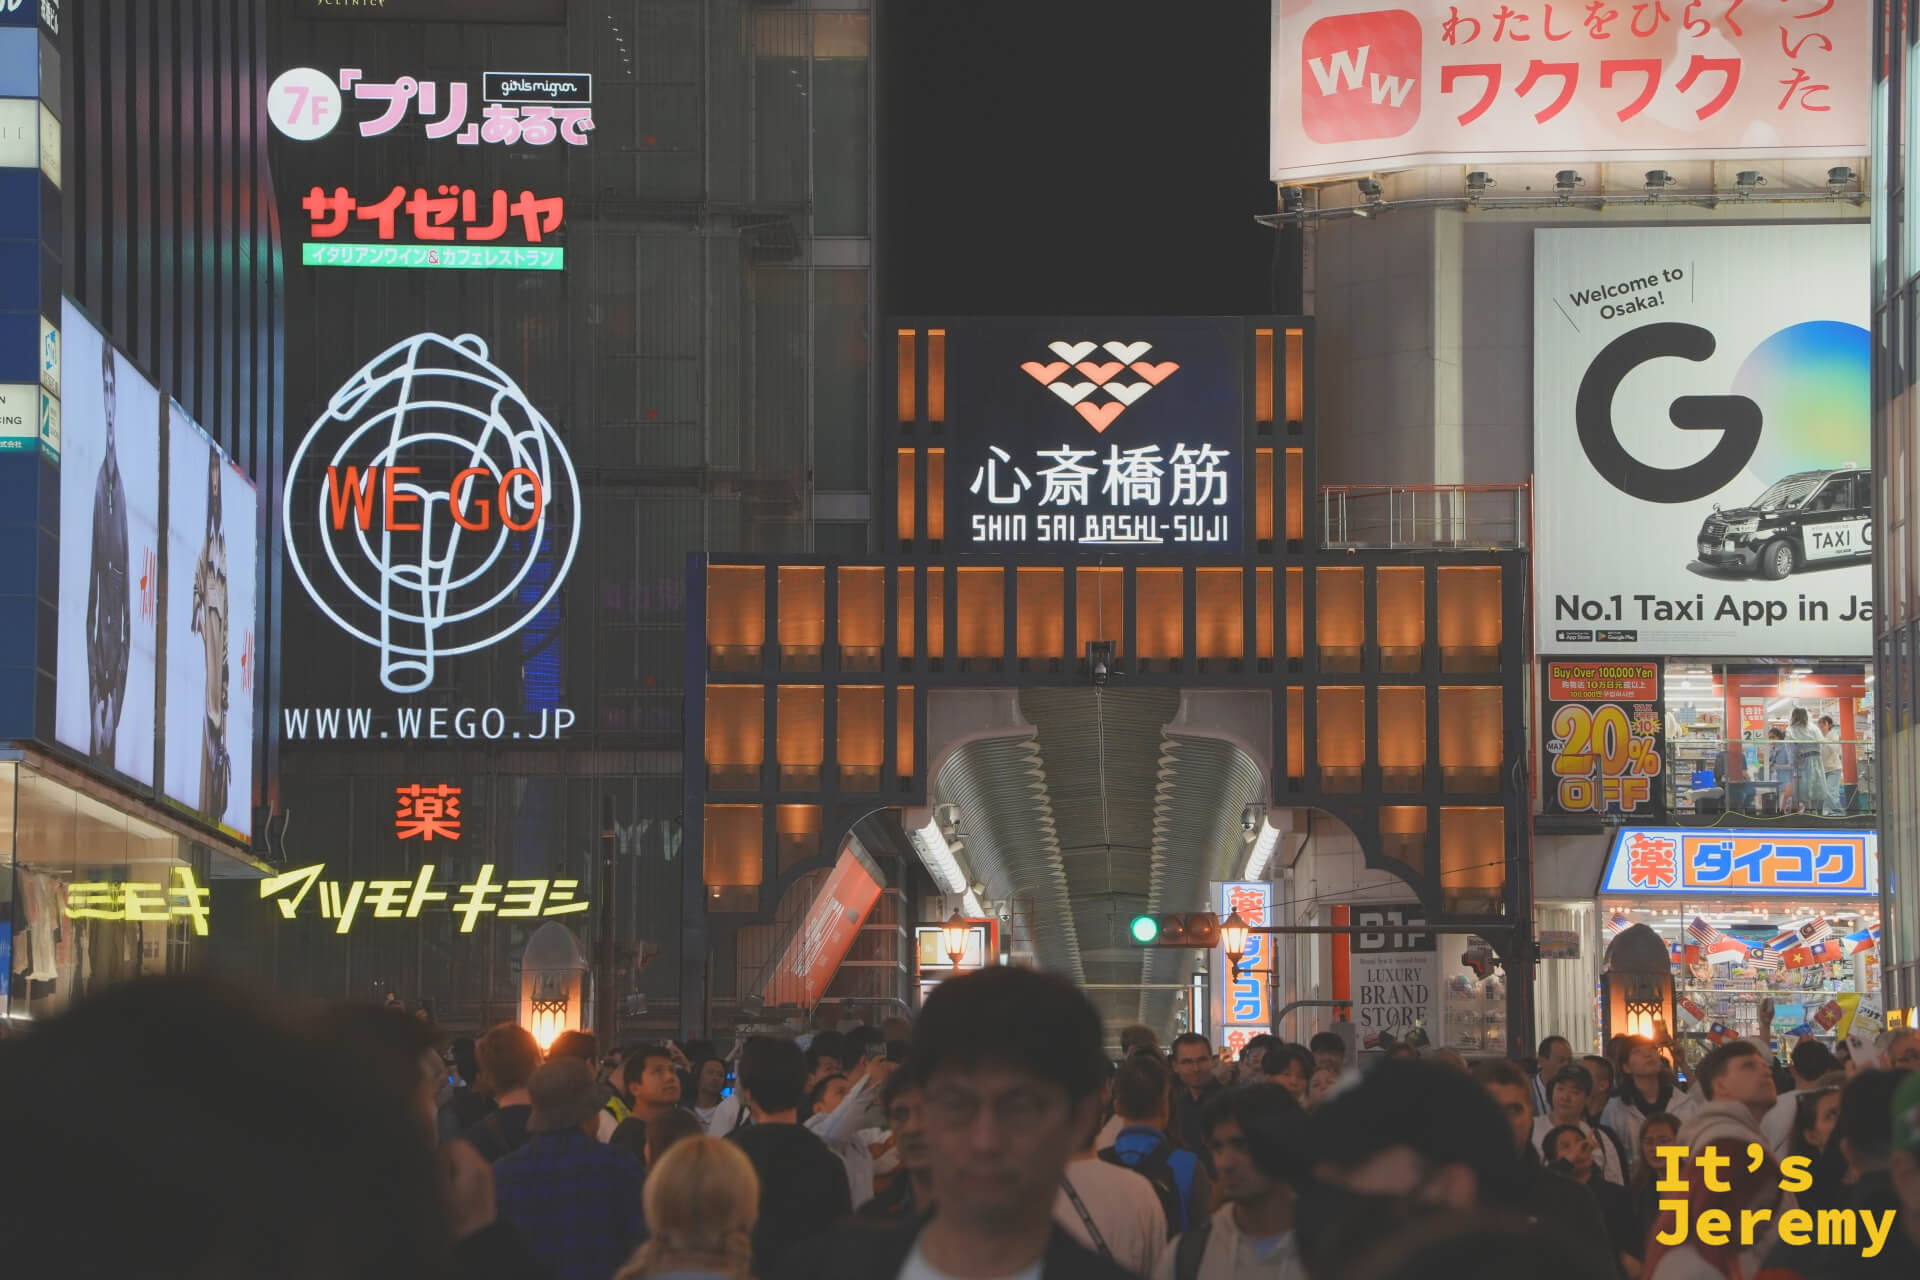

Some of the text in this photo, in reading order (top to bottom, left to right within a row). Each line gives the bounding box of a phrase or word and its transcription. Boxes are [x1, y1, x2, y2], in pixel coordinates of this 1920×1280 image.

[1442, 0, 1744, 46] わたしをひらく
[283, 85, 330, 126] 7F
[1440, 54, 1742, 127] ワクワク
[302, 184, 565, 243] サイゼリヤ
[1569, 268, 1684, 307] Welcome to
[1600, 290, 1665, 320] Osaka!
[969, 443, 1231, 506] 心斎橋筋
[327, 465, 544, 532] WE GO
[972, 514, 1026, 541] SHIN
[1037, 514, 1075, 541] SAI
[1813, 530, 1851, 549] TAXI
[1555, 595, 1622, 621] No.1
[1634, 594, 1704, 621] Taxi
[1714, 595, 1788, 627] App
[1799, 594, 1829, 621] in
[1553, 666, 1653, 680] Buy Over 100,000 Yen
[284, 708, 576, 740] WWW.WEGO.JP
[1552, 704, 1661, 777] 20%
[395, 783, 462, 842] 薬
[1558, 776, 1651, 812] OFF
[1626, 833, 1679, 888] 薬
[1693, 842, 1856, 884] ダイコク
[259, 863, 591, 934] マツモトキヨシ
[1360, 984, 1429, 1005] BRAND
[1367, 967, 1422, 983] LUXURY
[1360, 1006, 1428, 1027] STORE
